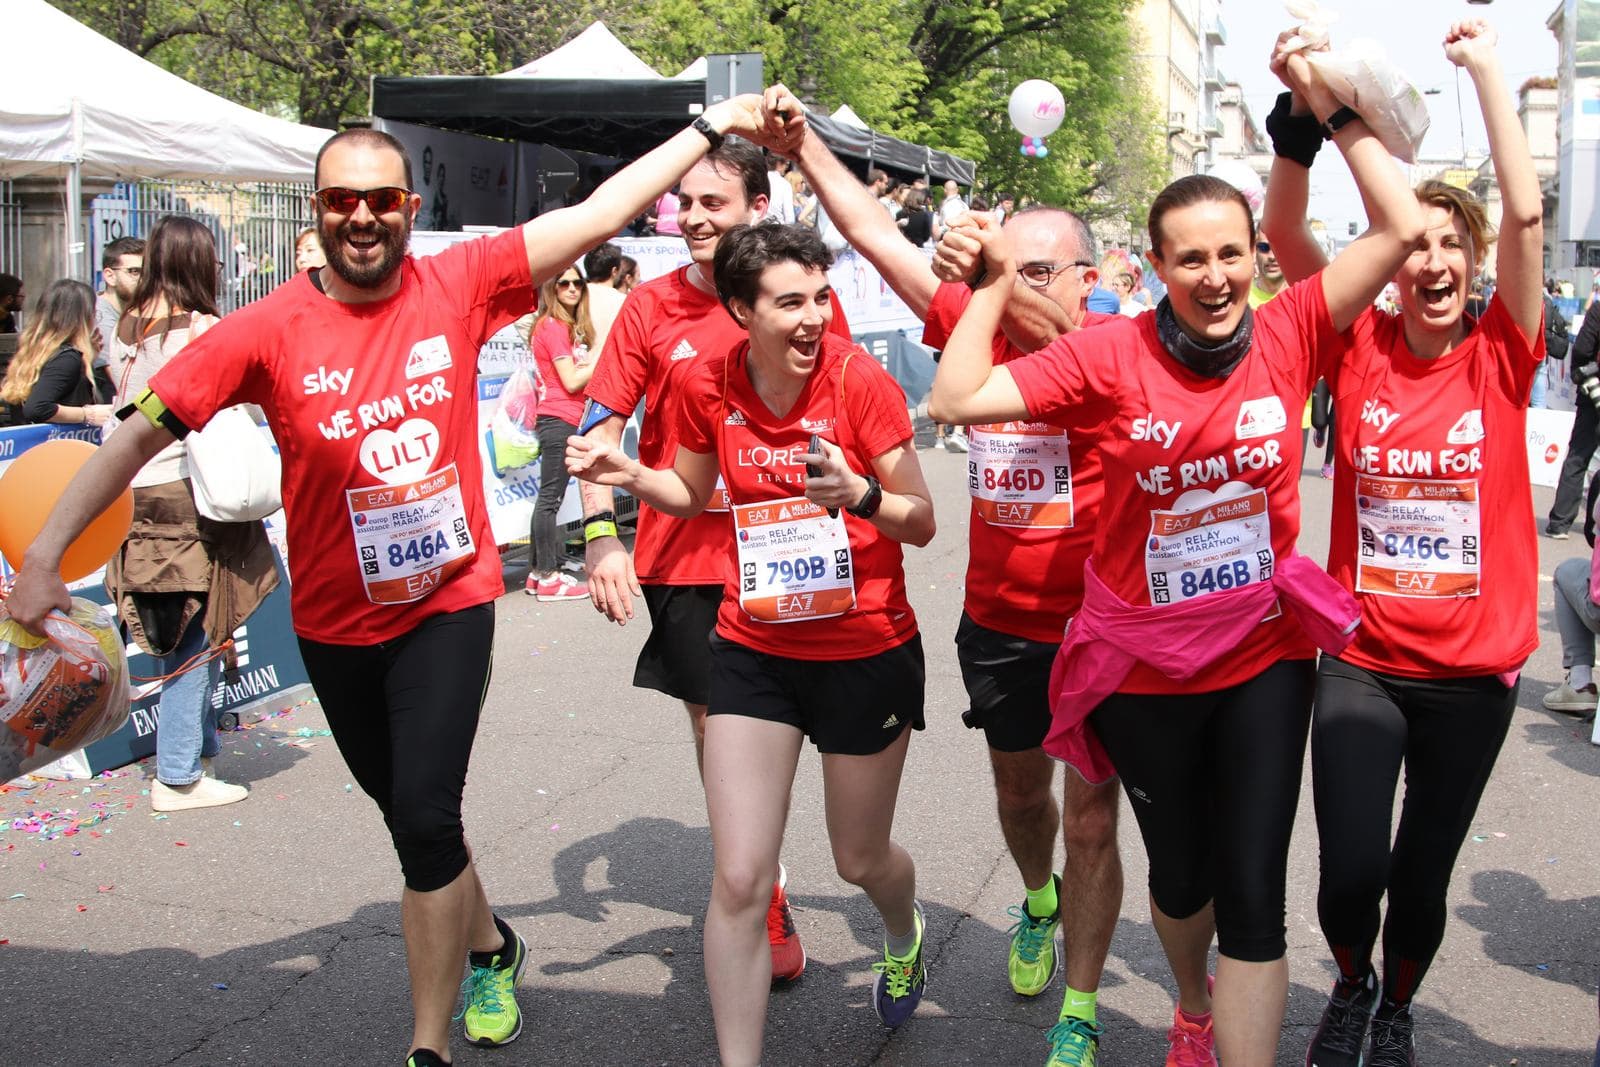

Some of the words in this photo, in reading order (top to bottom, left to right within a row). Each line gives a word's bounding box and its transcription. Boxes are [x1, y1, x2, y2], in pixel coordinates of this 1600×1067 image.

[621, 245, 651, 254] RELAY
[303, 366, 354, 396] sky
[317, 409, 357, 441] WE
[357, 395, 406, 430] RUN
[405, 376, 453, 411] FOR
[1361, 399, 1401, 434] sky
[1130, 412, 1182, 449] sky
[371, 432, 432, 474] LILT
[989, 439, 1019, 448] RELAY
[1135, 465, 1174, 496] WE
[1179, 454, 1229, 489] RUN
[1233, 439, 1283, 474] FOR
[1353, 445, 1381, 474] WE
[1386, 448, 1433, 476] RUN
[1439, 447, 1483, 475] FOR
[756, 472, 805, 484] ITALI
[983, 467, 1046, 492] 846D
[367, 490, 395, 505] EA7
[1372, 484, 1399, 496] EA7
[392, 506, 425, 519] RELAY
[393, 508, 441, 528] MARATHON
[748, 508, 770, 521] EA7
[996, 503, 1033, 520] EA7
[1163, 516, 1193, 532] EA7
[1216, 500, 1250, 513] MILANO
[1392, 506, 1427, 515] RELAY
[769, 527, 798, 539] RELAY
[770, 533, 816, 546] MARATHON
[1185, 530, 1221, 546] RELAY
[387, 529, 450, 568] 846A
[1160, 543, 1182, 553] europ
[1187, 535, 1241, 554] MARATHON
[1384, 533, 1451, 561] 846C
[1148, 550, 1183, 560] assistance
[766, 555, 826, 585] 790B
[1180, 560, 1251, 598] 846B
[406, 568, 442, 594] EA7
[1395, 571, 1438, 590] EA7
[776, 593, 815, 614] EA7
[225, 664, 280, 705] ARMANI
